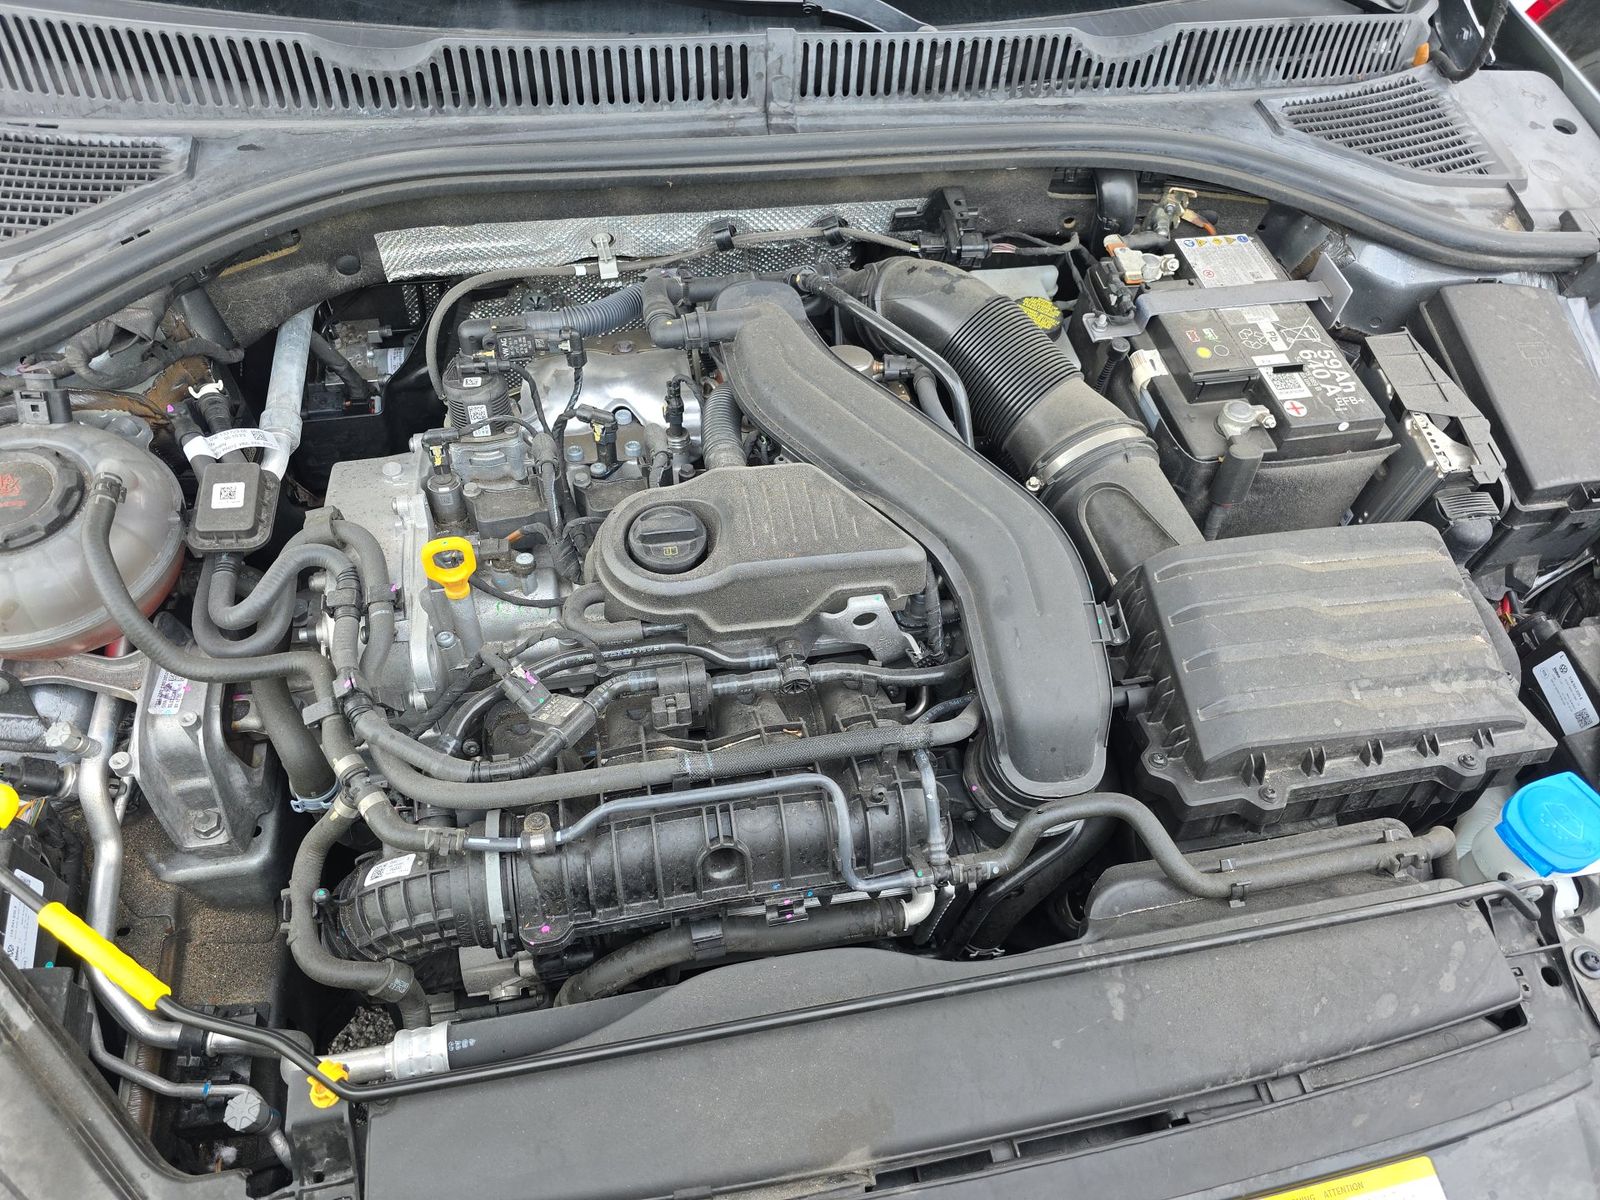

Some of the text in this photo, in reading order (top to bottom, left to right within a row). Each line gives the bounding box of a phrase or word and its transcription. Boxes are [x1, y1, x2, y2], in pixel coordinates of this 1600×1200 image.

[1266, 330, 1279, 343] Pb
[1298, 349, 1331, 379] 640
[1320, 383, 1342, 397] A
[1317, 349, 1356, 393] 59Ah
[1334, 395, 1366, 406] EFB+
[1323, 1181, 1364, 1199] ATTENTION
